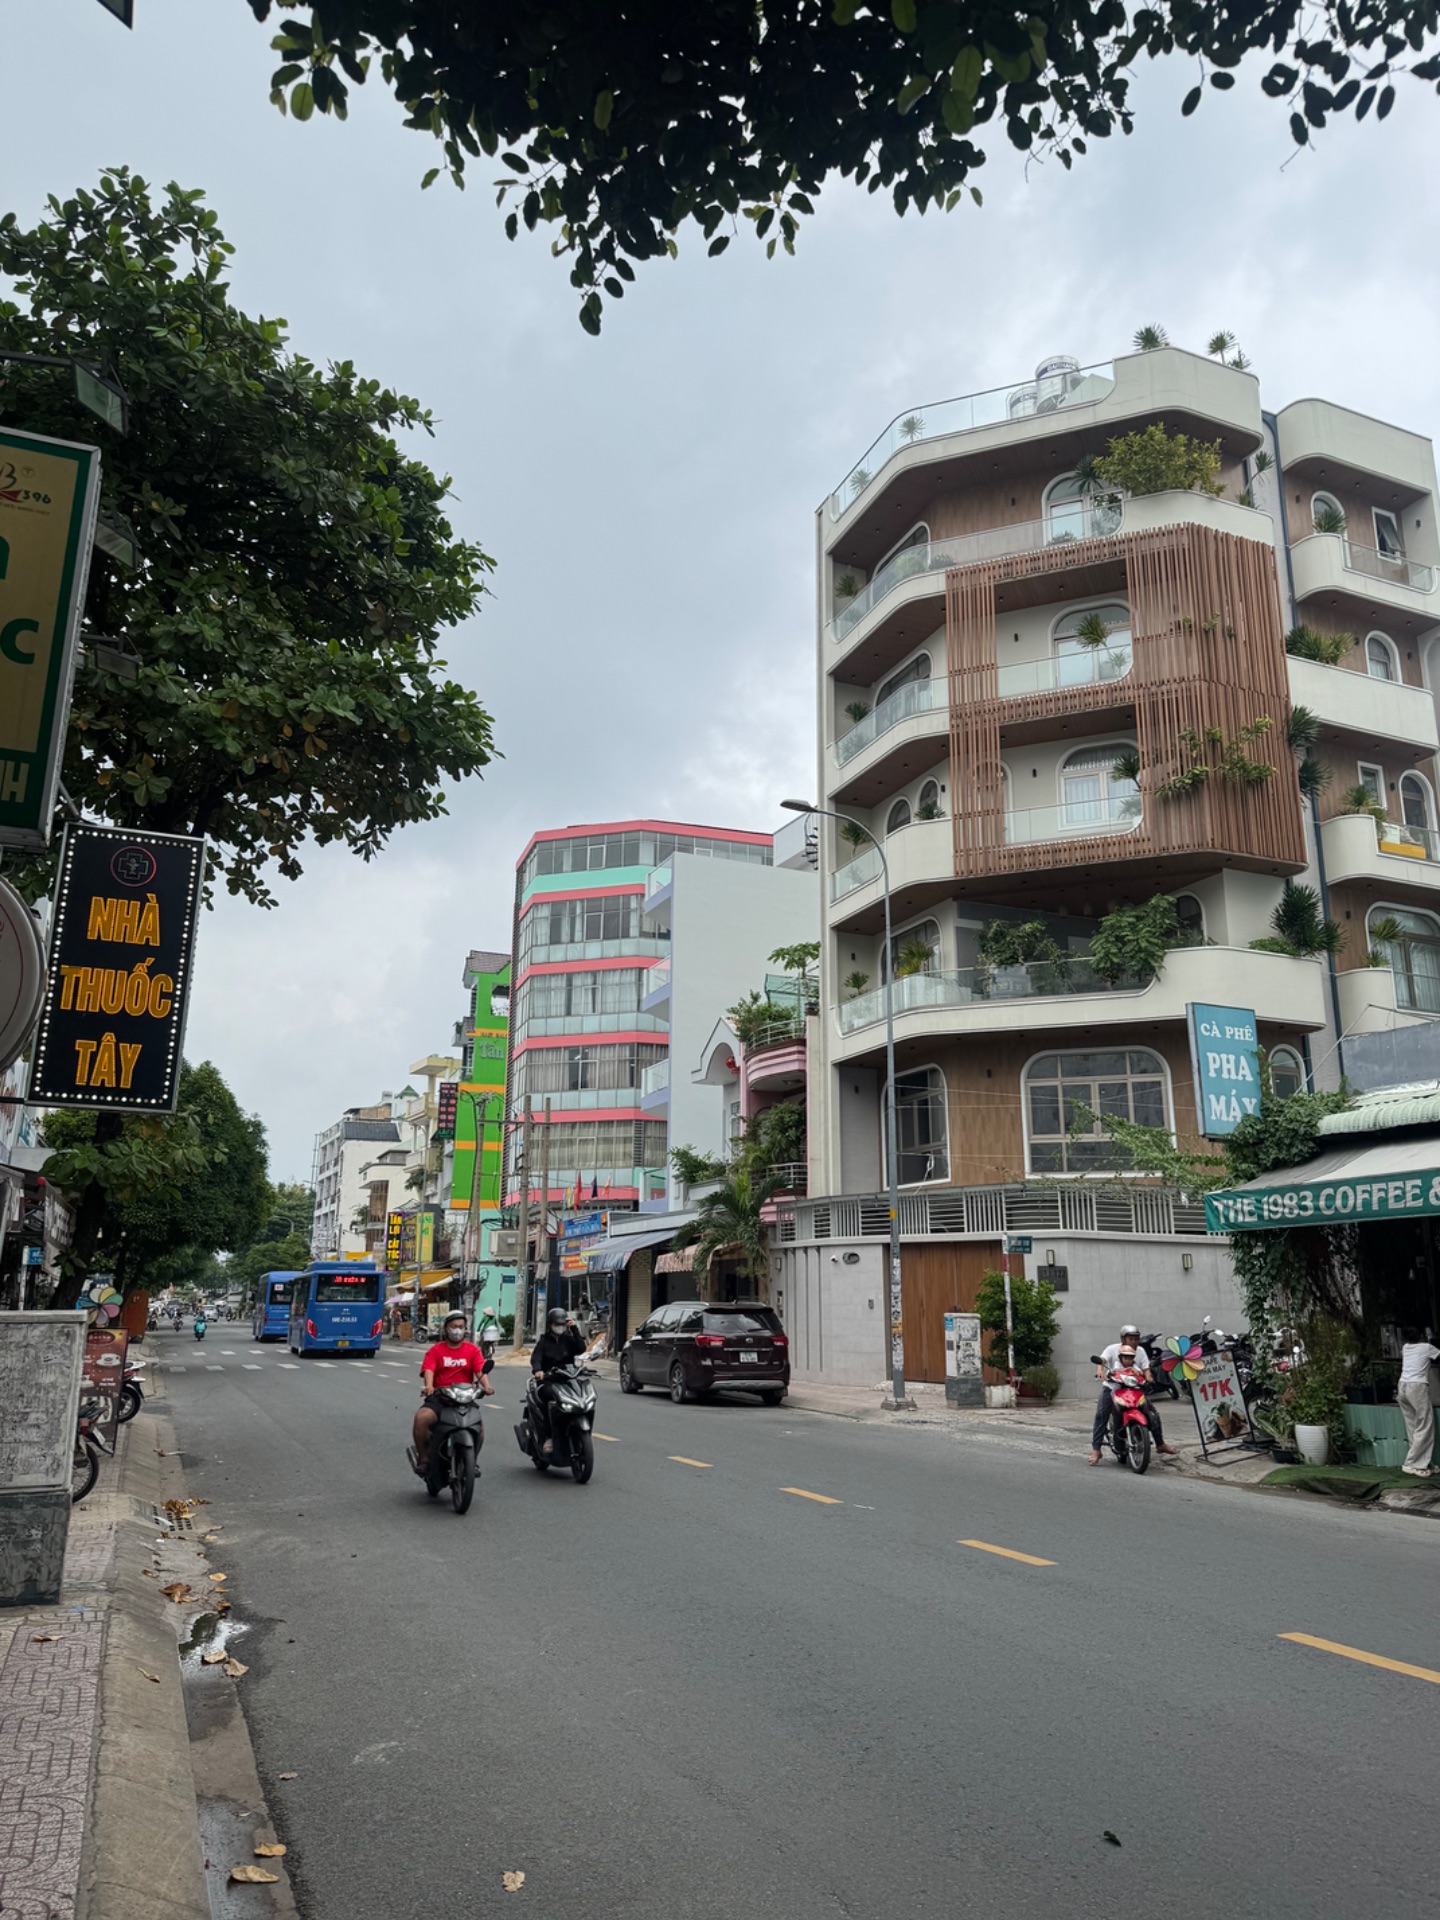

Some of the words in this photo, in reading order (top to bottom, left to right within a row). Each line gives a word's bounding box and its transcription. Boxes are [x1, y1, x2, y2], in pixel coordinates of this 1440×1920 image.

[87, 893, 161, 947] NHÀ
[60, 958, 174, 1019] THUỐC
[1200, 1020, 1222, 1039] CÀ
[1225, 1025, 1254, 1042] PHÊ
[75, 1032, 143, 1089] TÂY
[1206, 1052, 1254, 1082] PHA
[1208, 1089, 1258, 1122] MÁY
[1213, 1198, 1258, 1225] THE
[1261, 1190, 1315, 1221] 1983
[1319, 1179, 1424, 1216] COFFEE
[1199, 1377, 1235, 1402] 17K
